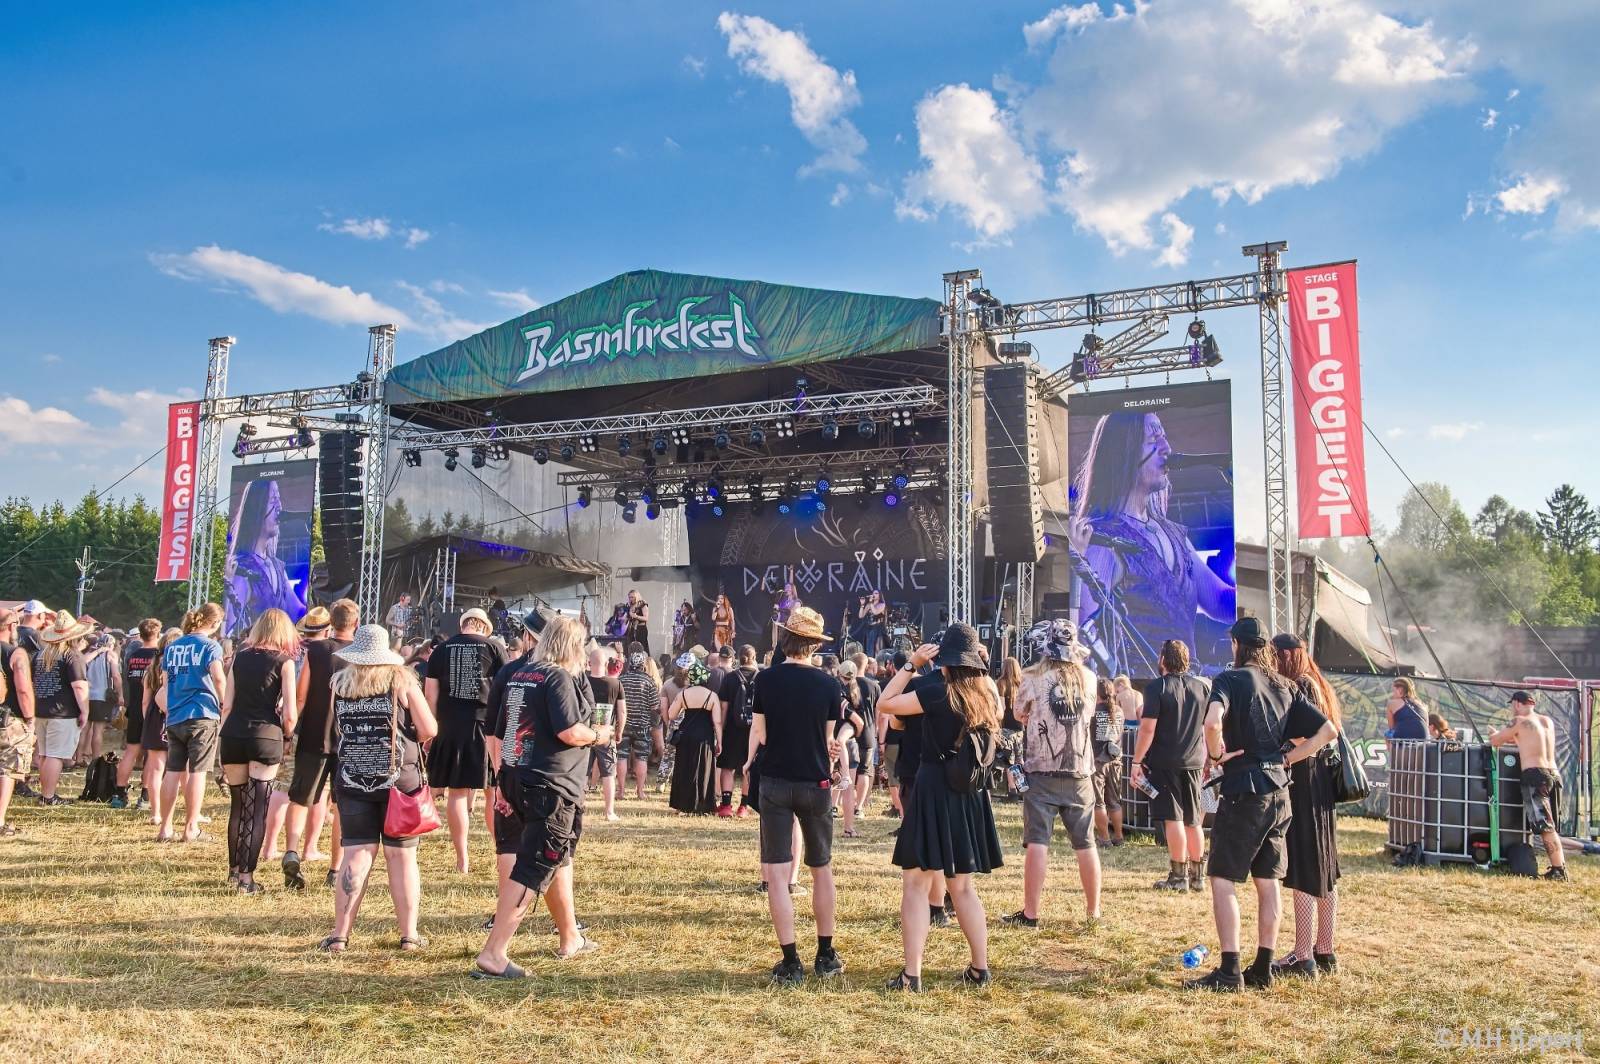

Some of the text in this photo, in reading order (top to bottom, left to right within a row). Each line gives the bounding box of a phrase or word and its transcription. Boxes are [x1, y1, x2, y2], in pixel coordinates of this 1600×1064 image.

[1305, 272, 1338, 284] STAGE
[1124, 398, 1171, 407] DELORAINE
[1306, 287, 1350, 537] BIGGEST
[168, 416, 193, 580] BIGGEST
[167, 644, 206, 667] CREW
